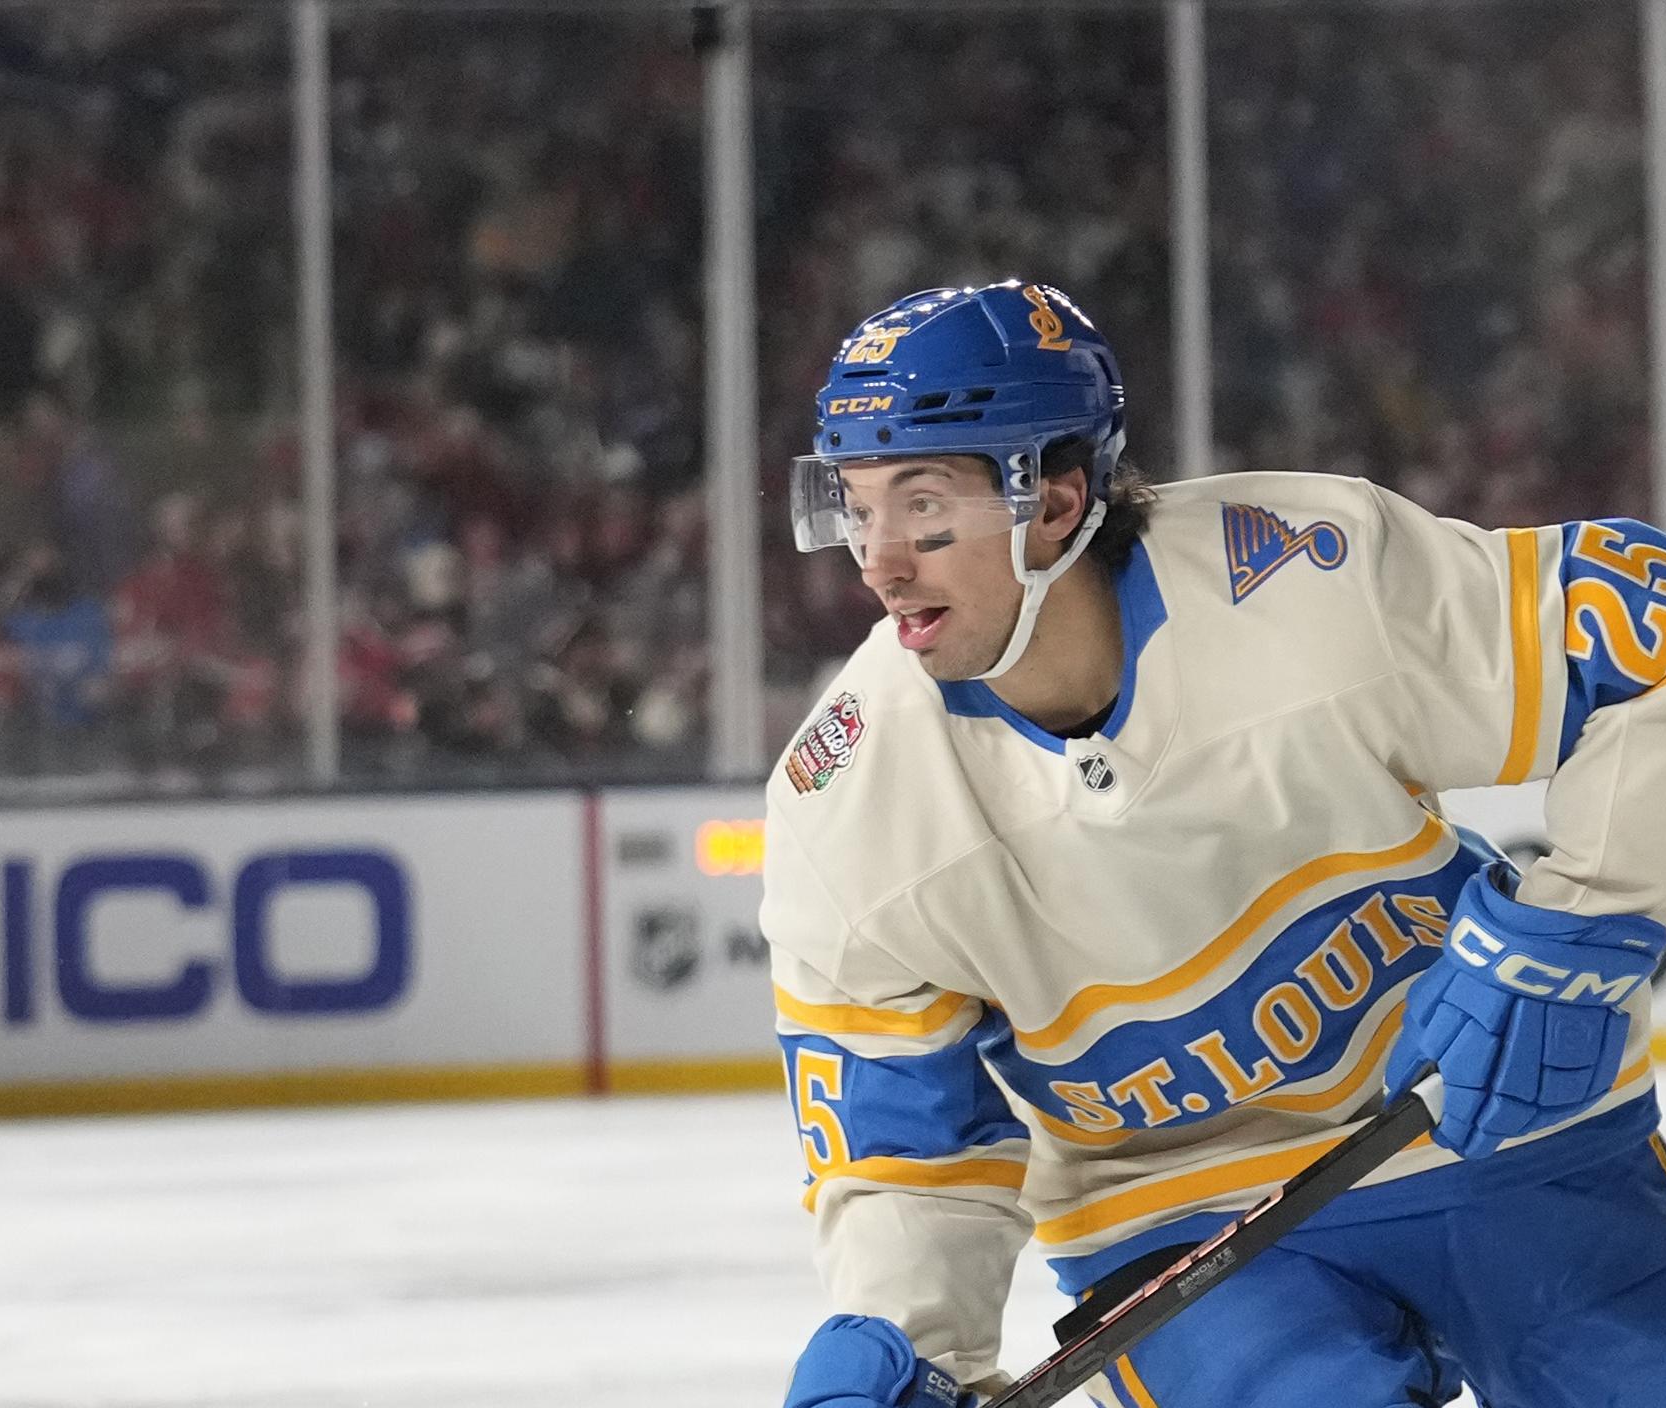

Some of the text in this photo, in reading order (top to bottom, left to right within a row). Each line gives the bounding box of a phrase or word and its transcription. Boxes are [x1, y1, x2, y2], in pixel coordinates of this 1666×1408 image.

[844, 327, 910, 364] 25
[829, 396, 893, 415] CCM
[1450, 914, 1644, 1003] CCM
[927, 1371, 959, 1398] CCM
